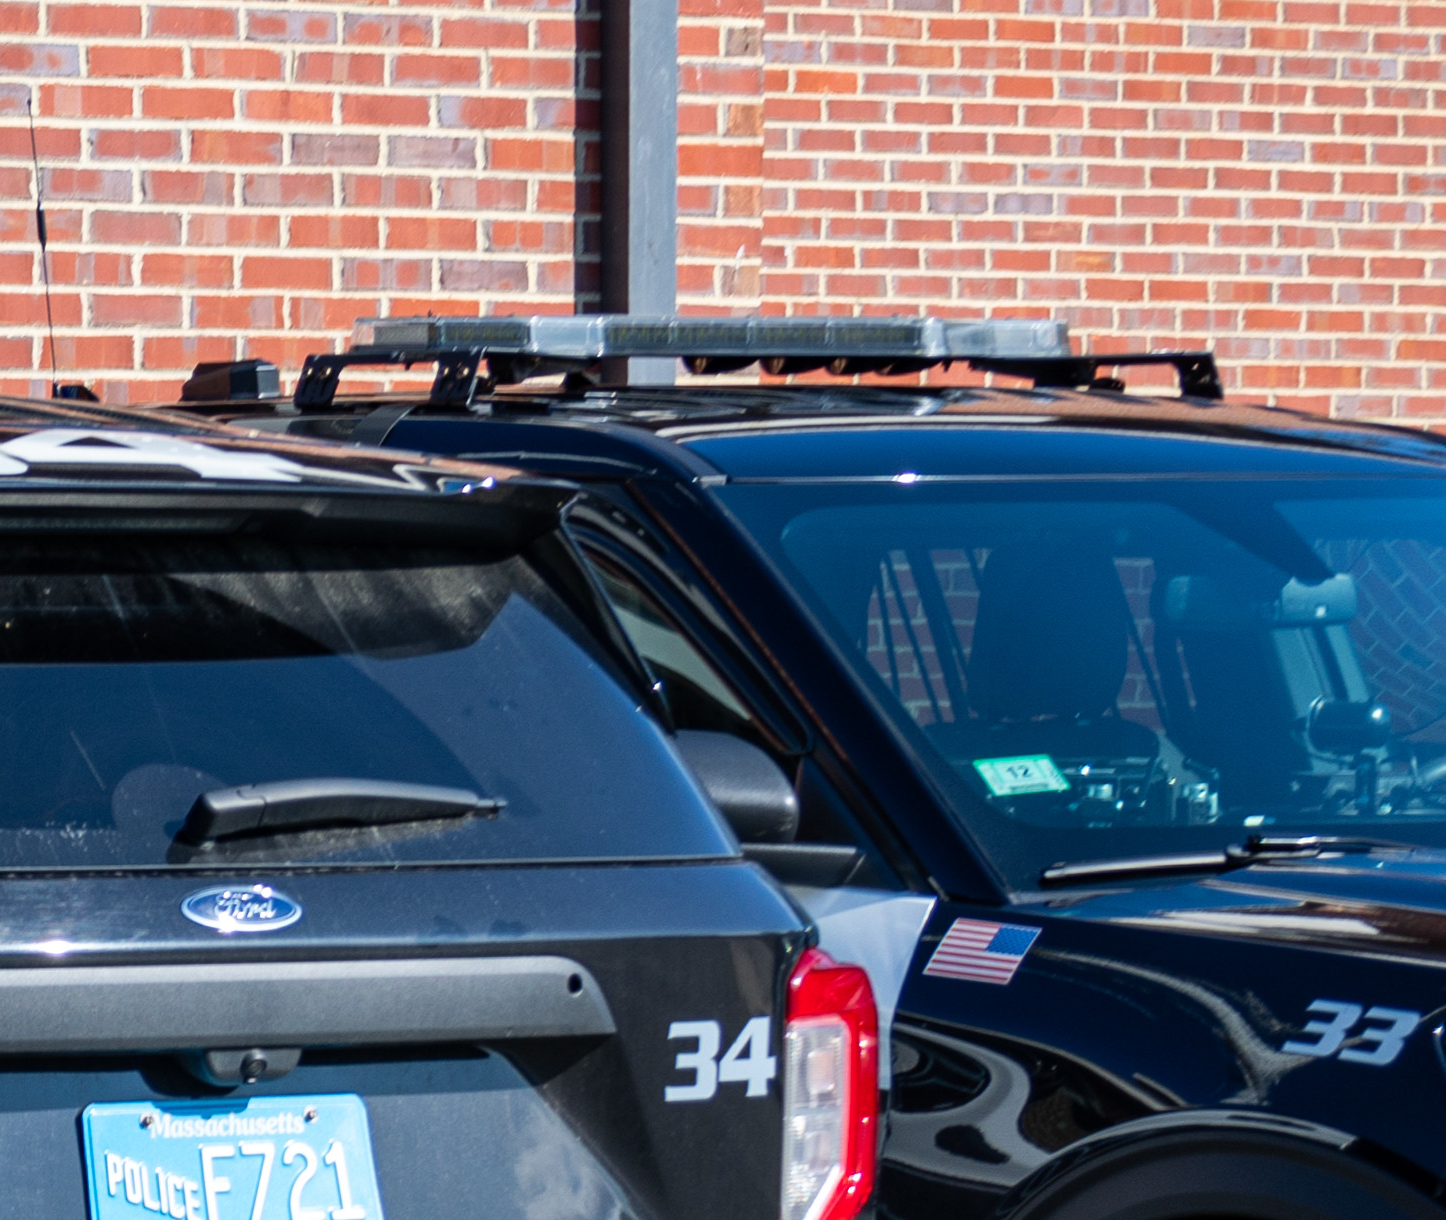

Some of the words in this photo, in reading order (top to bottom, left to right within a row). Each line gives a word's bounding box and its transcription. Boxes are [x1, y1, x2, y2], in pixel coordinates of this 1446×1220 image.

[214, 891, 277, 920] Ford
[1280, 998, 1423, 1067] 33
[664, 1015, 777, 1102] 34
[150, 1111, 305, 1138] Massachusetts
